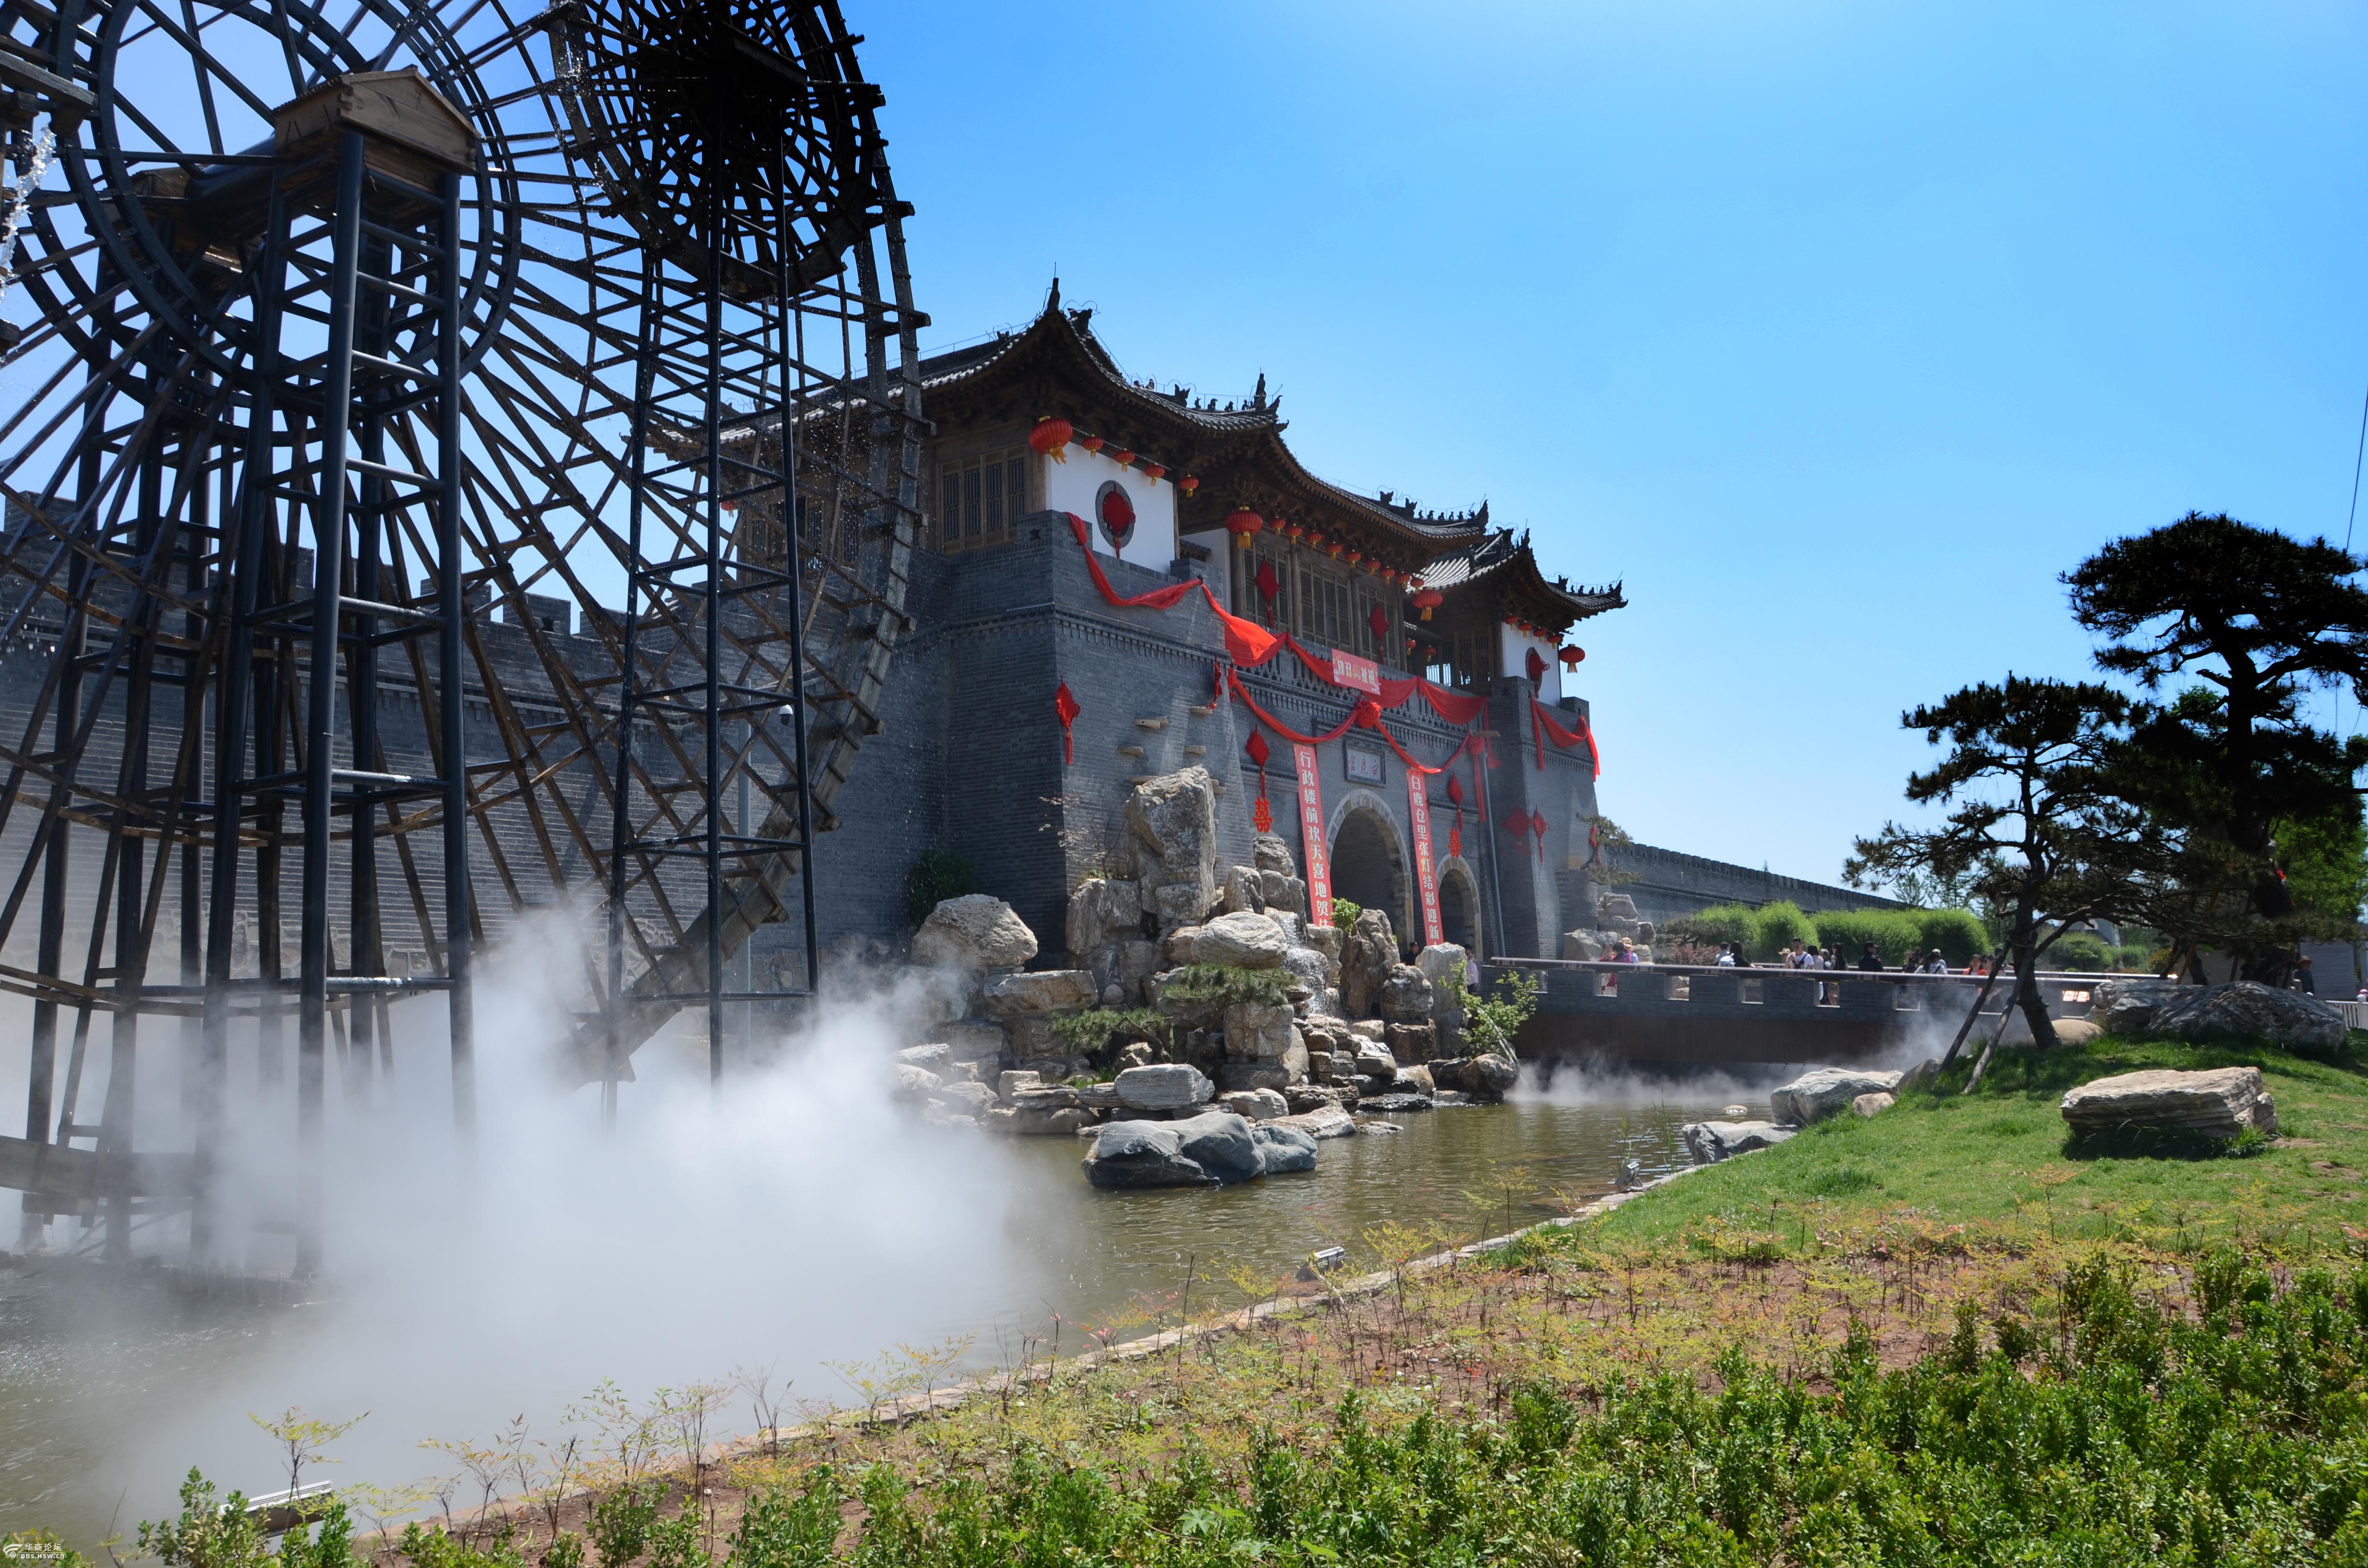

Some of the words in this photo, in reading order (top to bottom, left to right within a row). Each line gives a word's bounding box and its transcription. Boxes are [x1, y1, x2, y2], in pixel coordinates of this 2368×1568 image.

[1411, 775, 1440, 945] 白鹿仓里张灯结彩迎新
